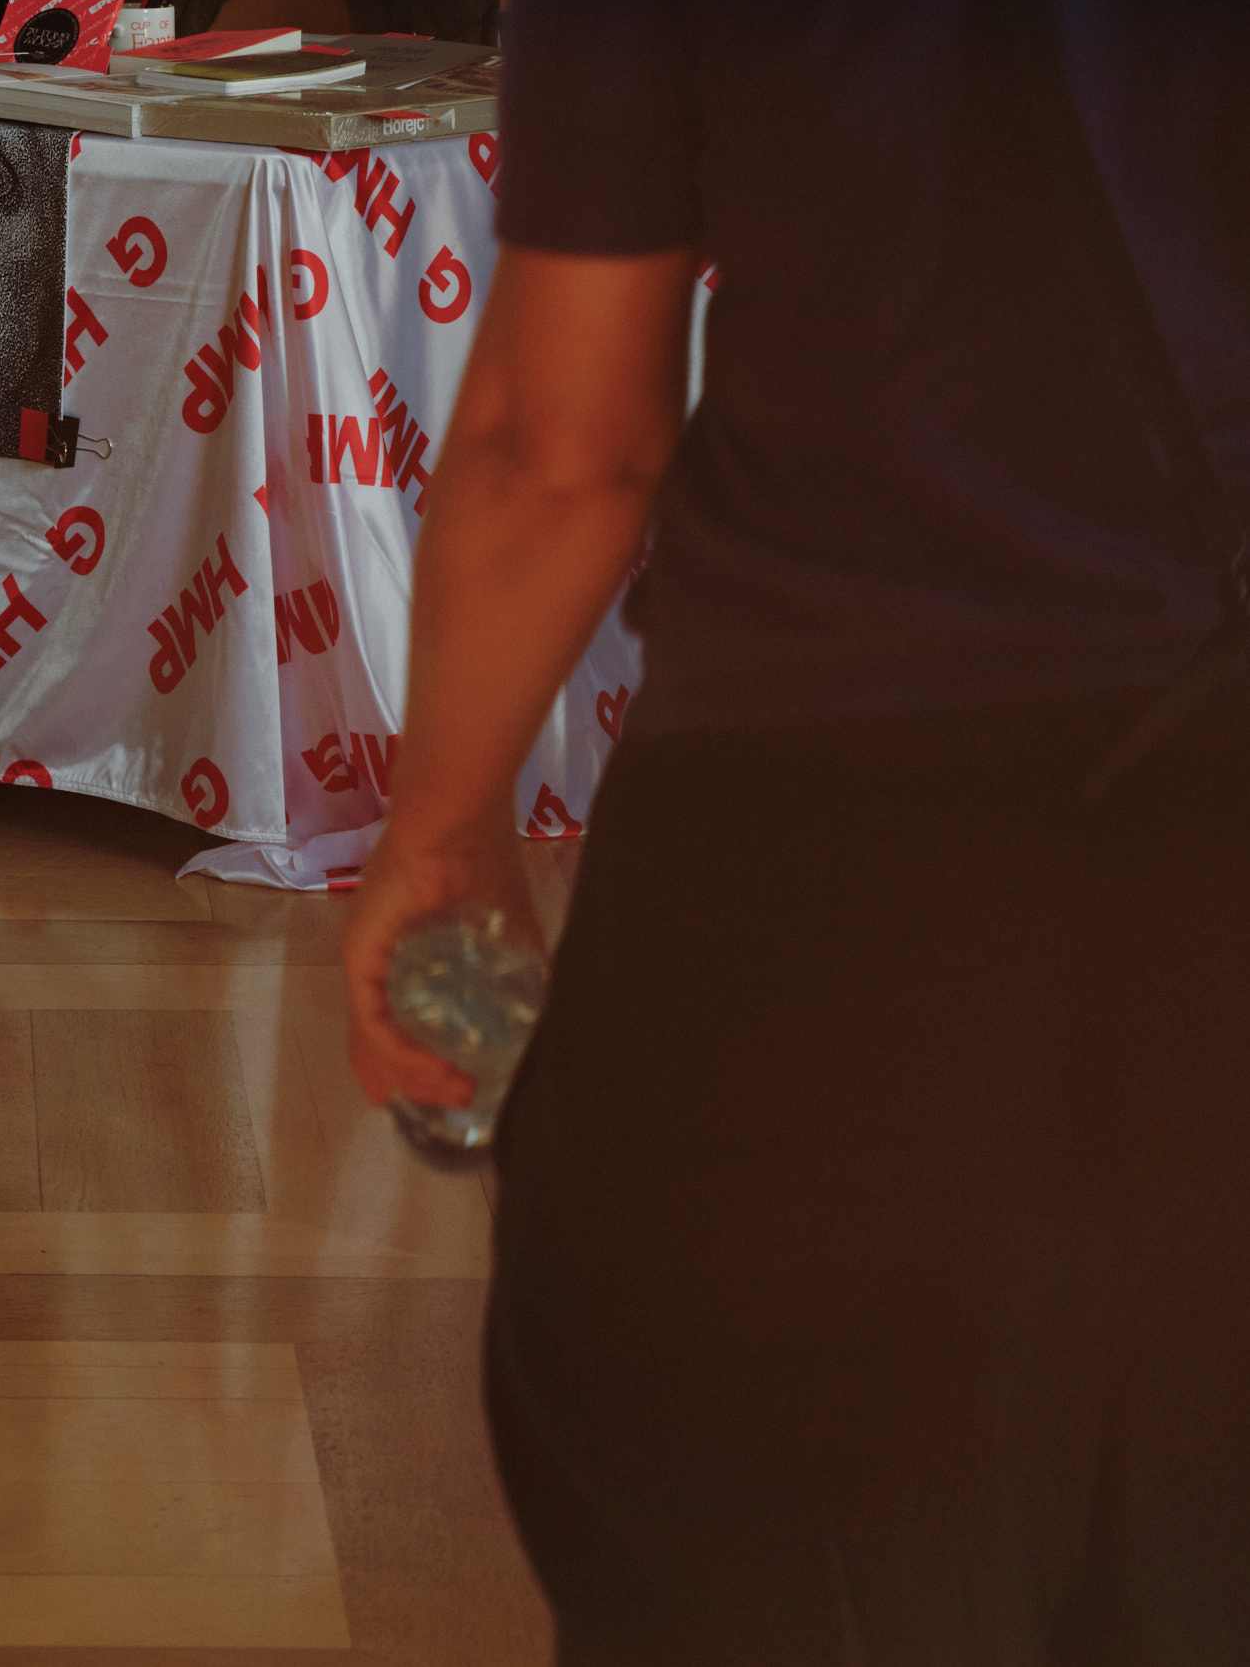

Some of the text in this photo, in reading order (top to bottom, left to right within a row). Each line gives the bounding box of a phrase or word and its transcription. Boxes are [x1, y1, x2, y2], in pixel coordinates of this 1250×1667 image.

[106, 215, 168, 288] G
[418, 244, 472, 324] G
[367, 367, 432, 516] HM
[45, 505, 106, 576] G
[147, 532, 249, 695] HMP
[181, 757, 230, 830] G
